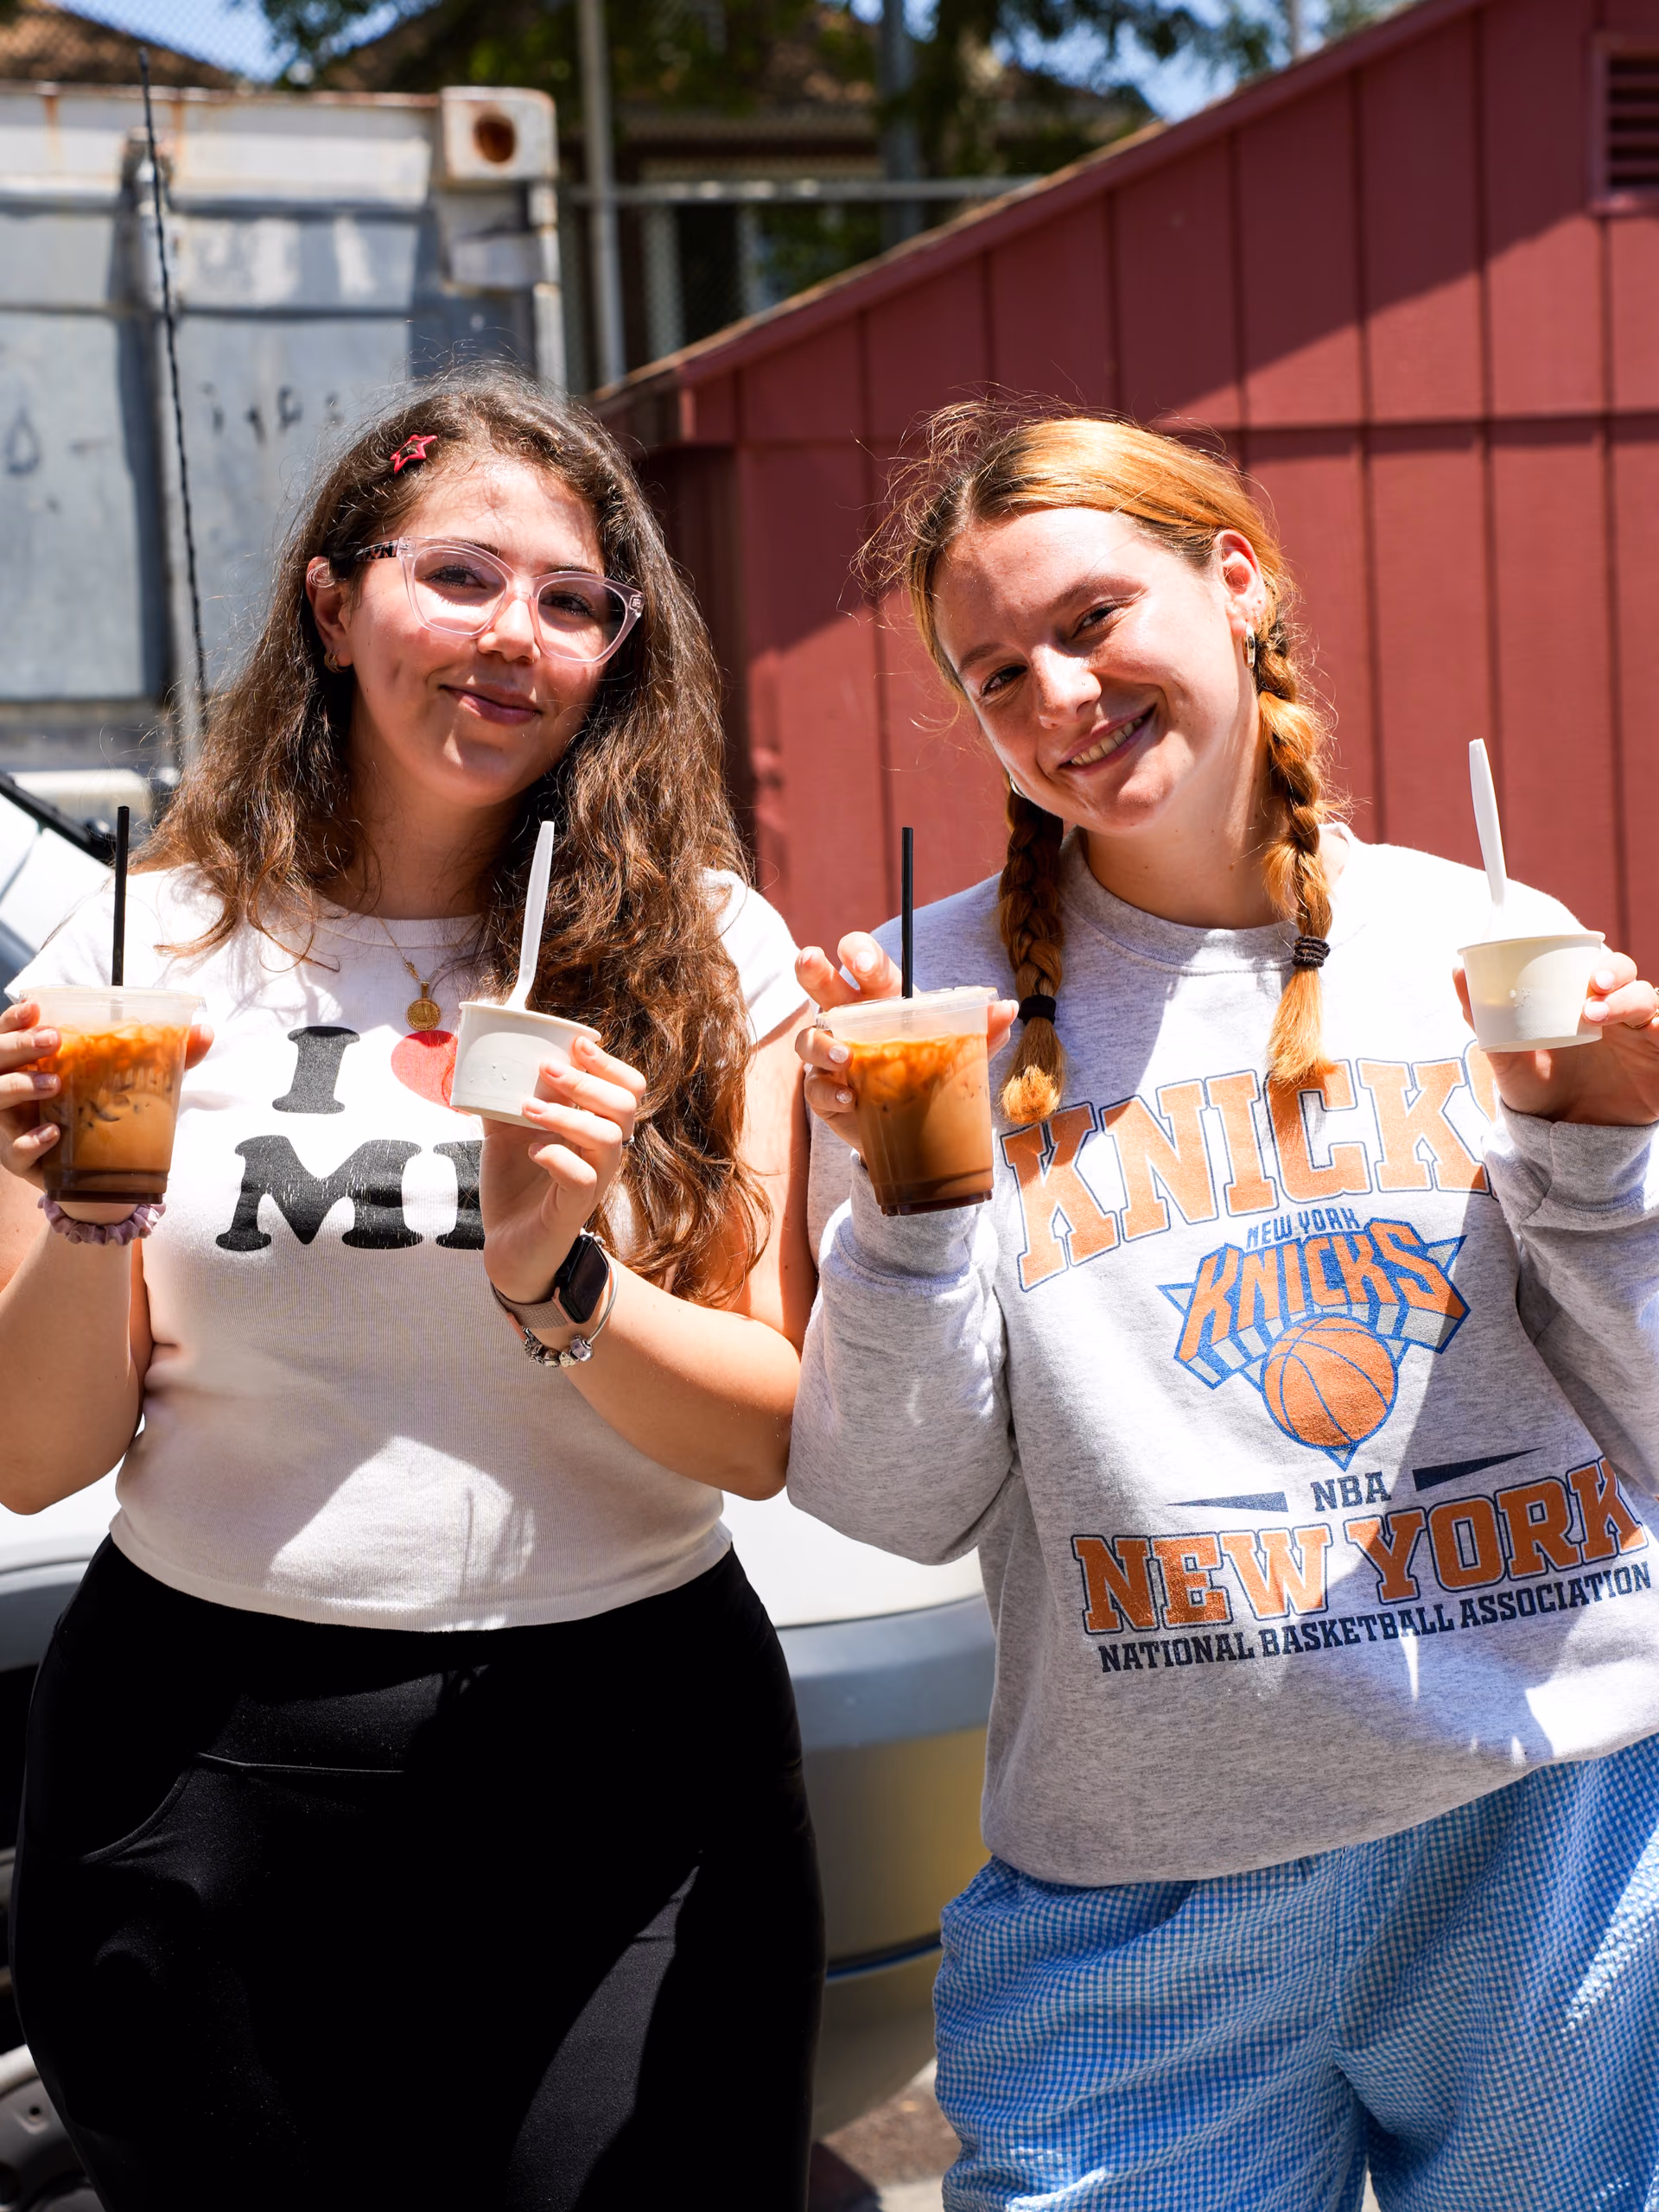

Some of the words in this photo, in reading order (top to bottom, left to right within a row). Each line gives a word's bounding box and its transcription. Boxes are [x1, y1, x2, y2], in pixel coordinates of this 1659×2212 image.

[272, 1026, 360, 1114] I
[1247, 1214, 1293, 1249] NEW
[1298, 1207, 1360, 1237] YORK
[1175, 1217, 1469, 1363] KNICKS
[1310, 1471, 1392, 1512] NBA
[1071, 1522, 1333, 1635] NEW
[1343, 1455, 1649, 1605] YORK
[1098, 1632, 1255, 1673] NATIONAL
[1259, 1603, 1454, 1656] BASKETBALL
[1460, 1560, 1651, 1629] ASSOCIATION
